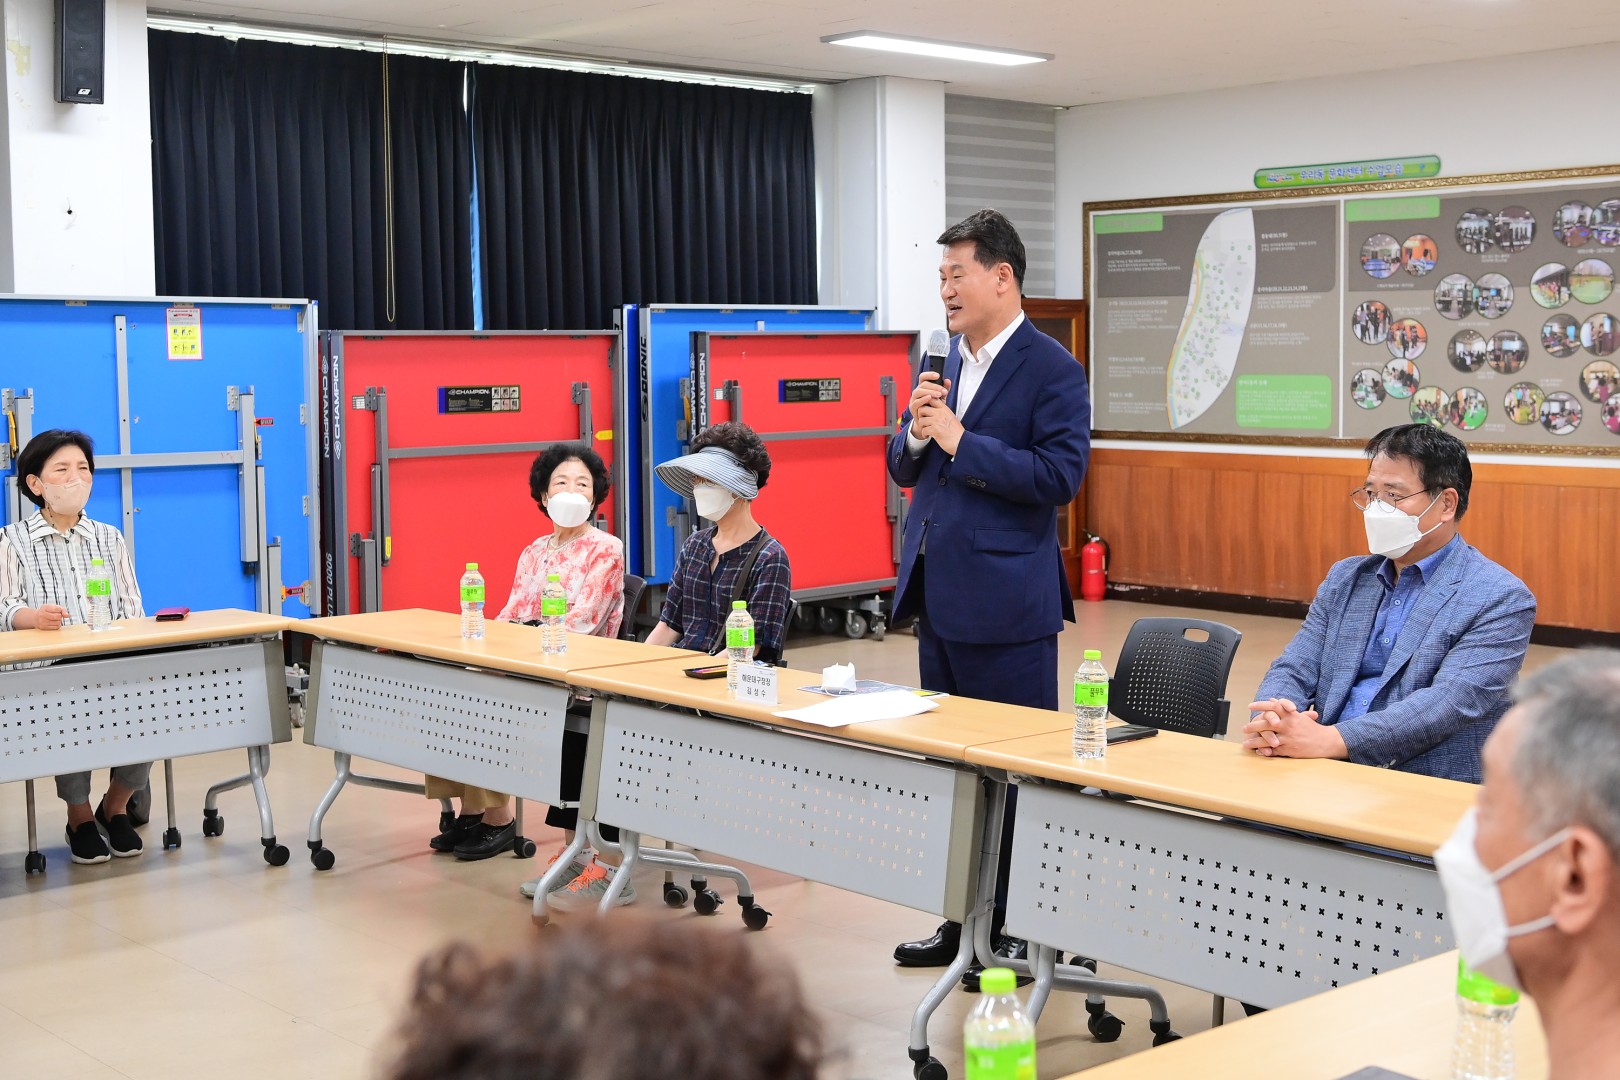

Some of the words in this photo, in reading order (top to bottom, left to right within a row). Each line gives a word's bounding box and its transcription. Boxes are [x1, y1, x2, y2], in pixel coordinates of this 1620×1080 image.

[322, 376, 330, 458] CHAMPION
[325, 552, 333, 585] 9000
[741, 674, 771, 687] 해운대구청장
